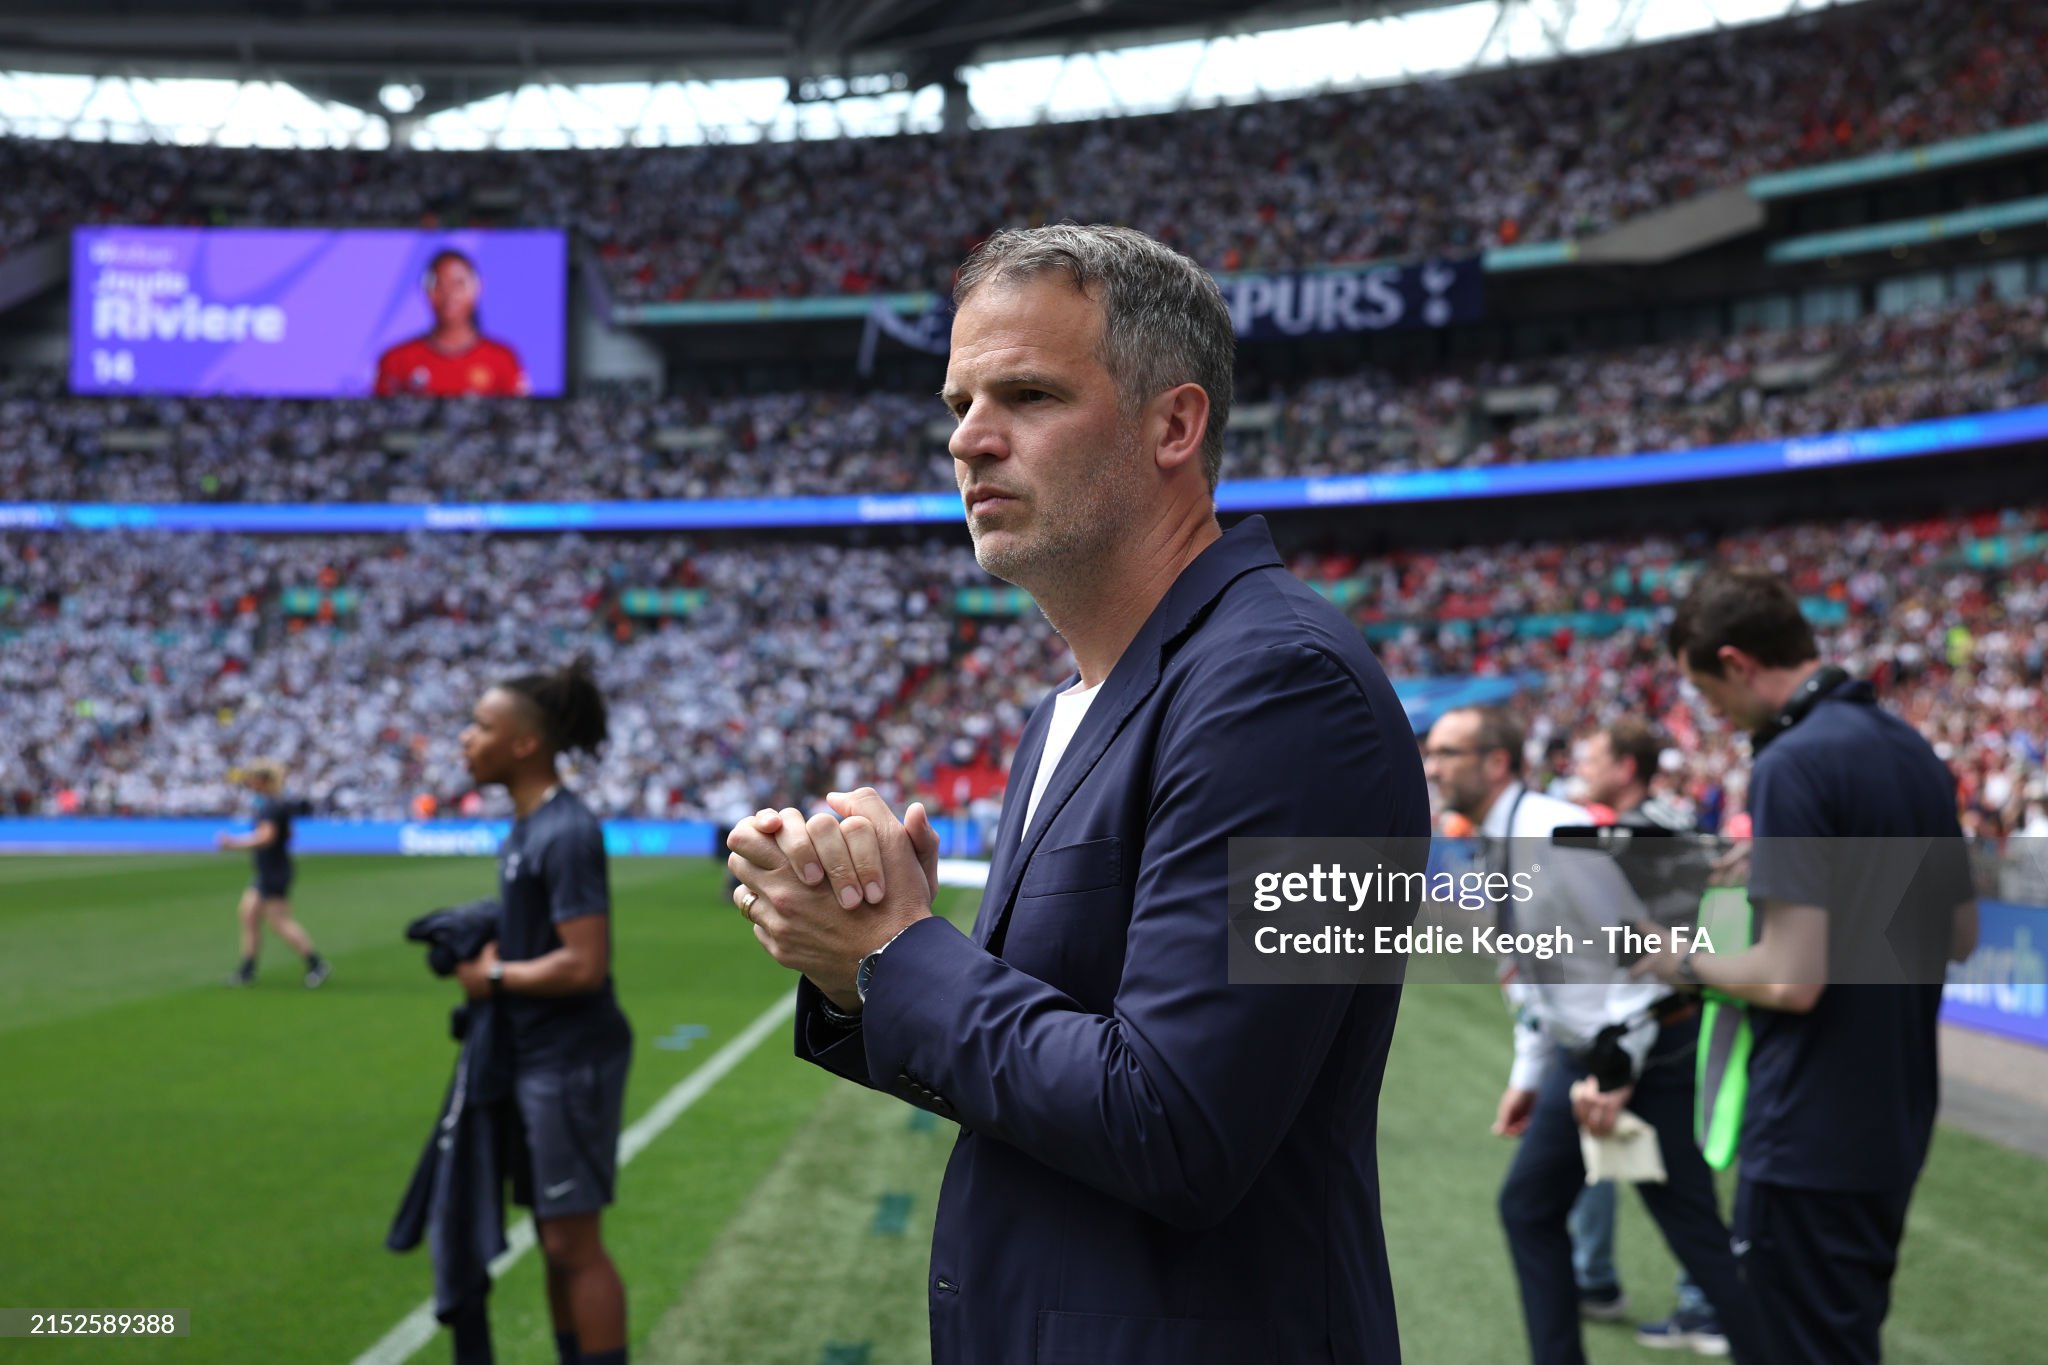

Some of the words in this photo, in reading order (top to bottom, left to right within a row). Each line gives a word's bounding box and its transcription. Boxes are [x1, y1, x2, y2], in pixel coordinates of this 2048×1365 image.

[93, 295, 287, 342] Riviere
[1231, 267, 1405, 336] PURS
[400, 821, 498, 855] Search
